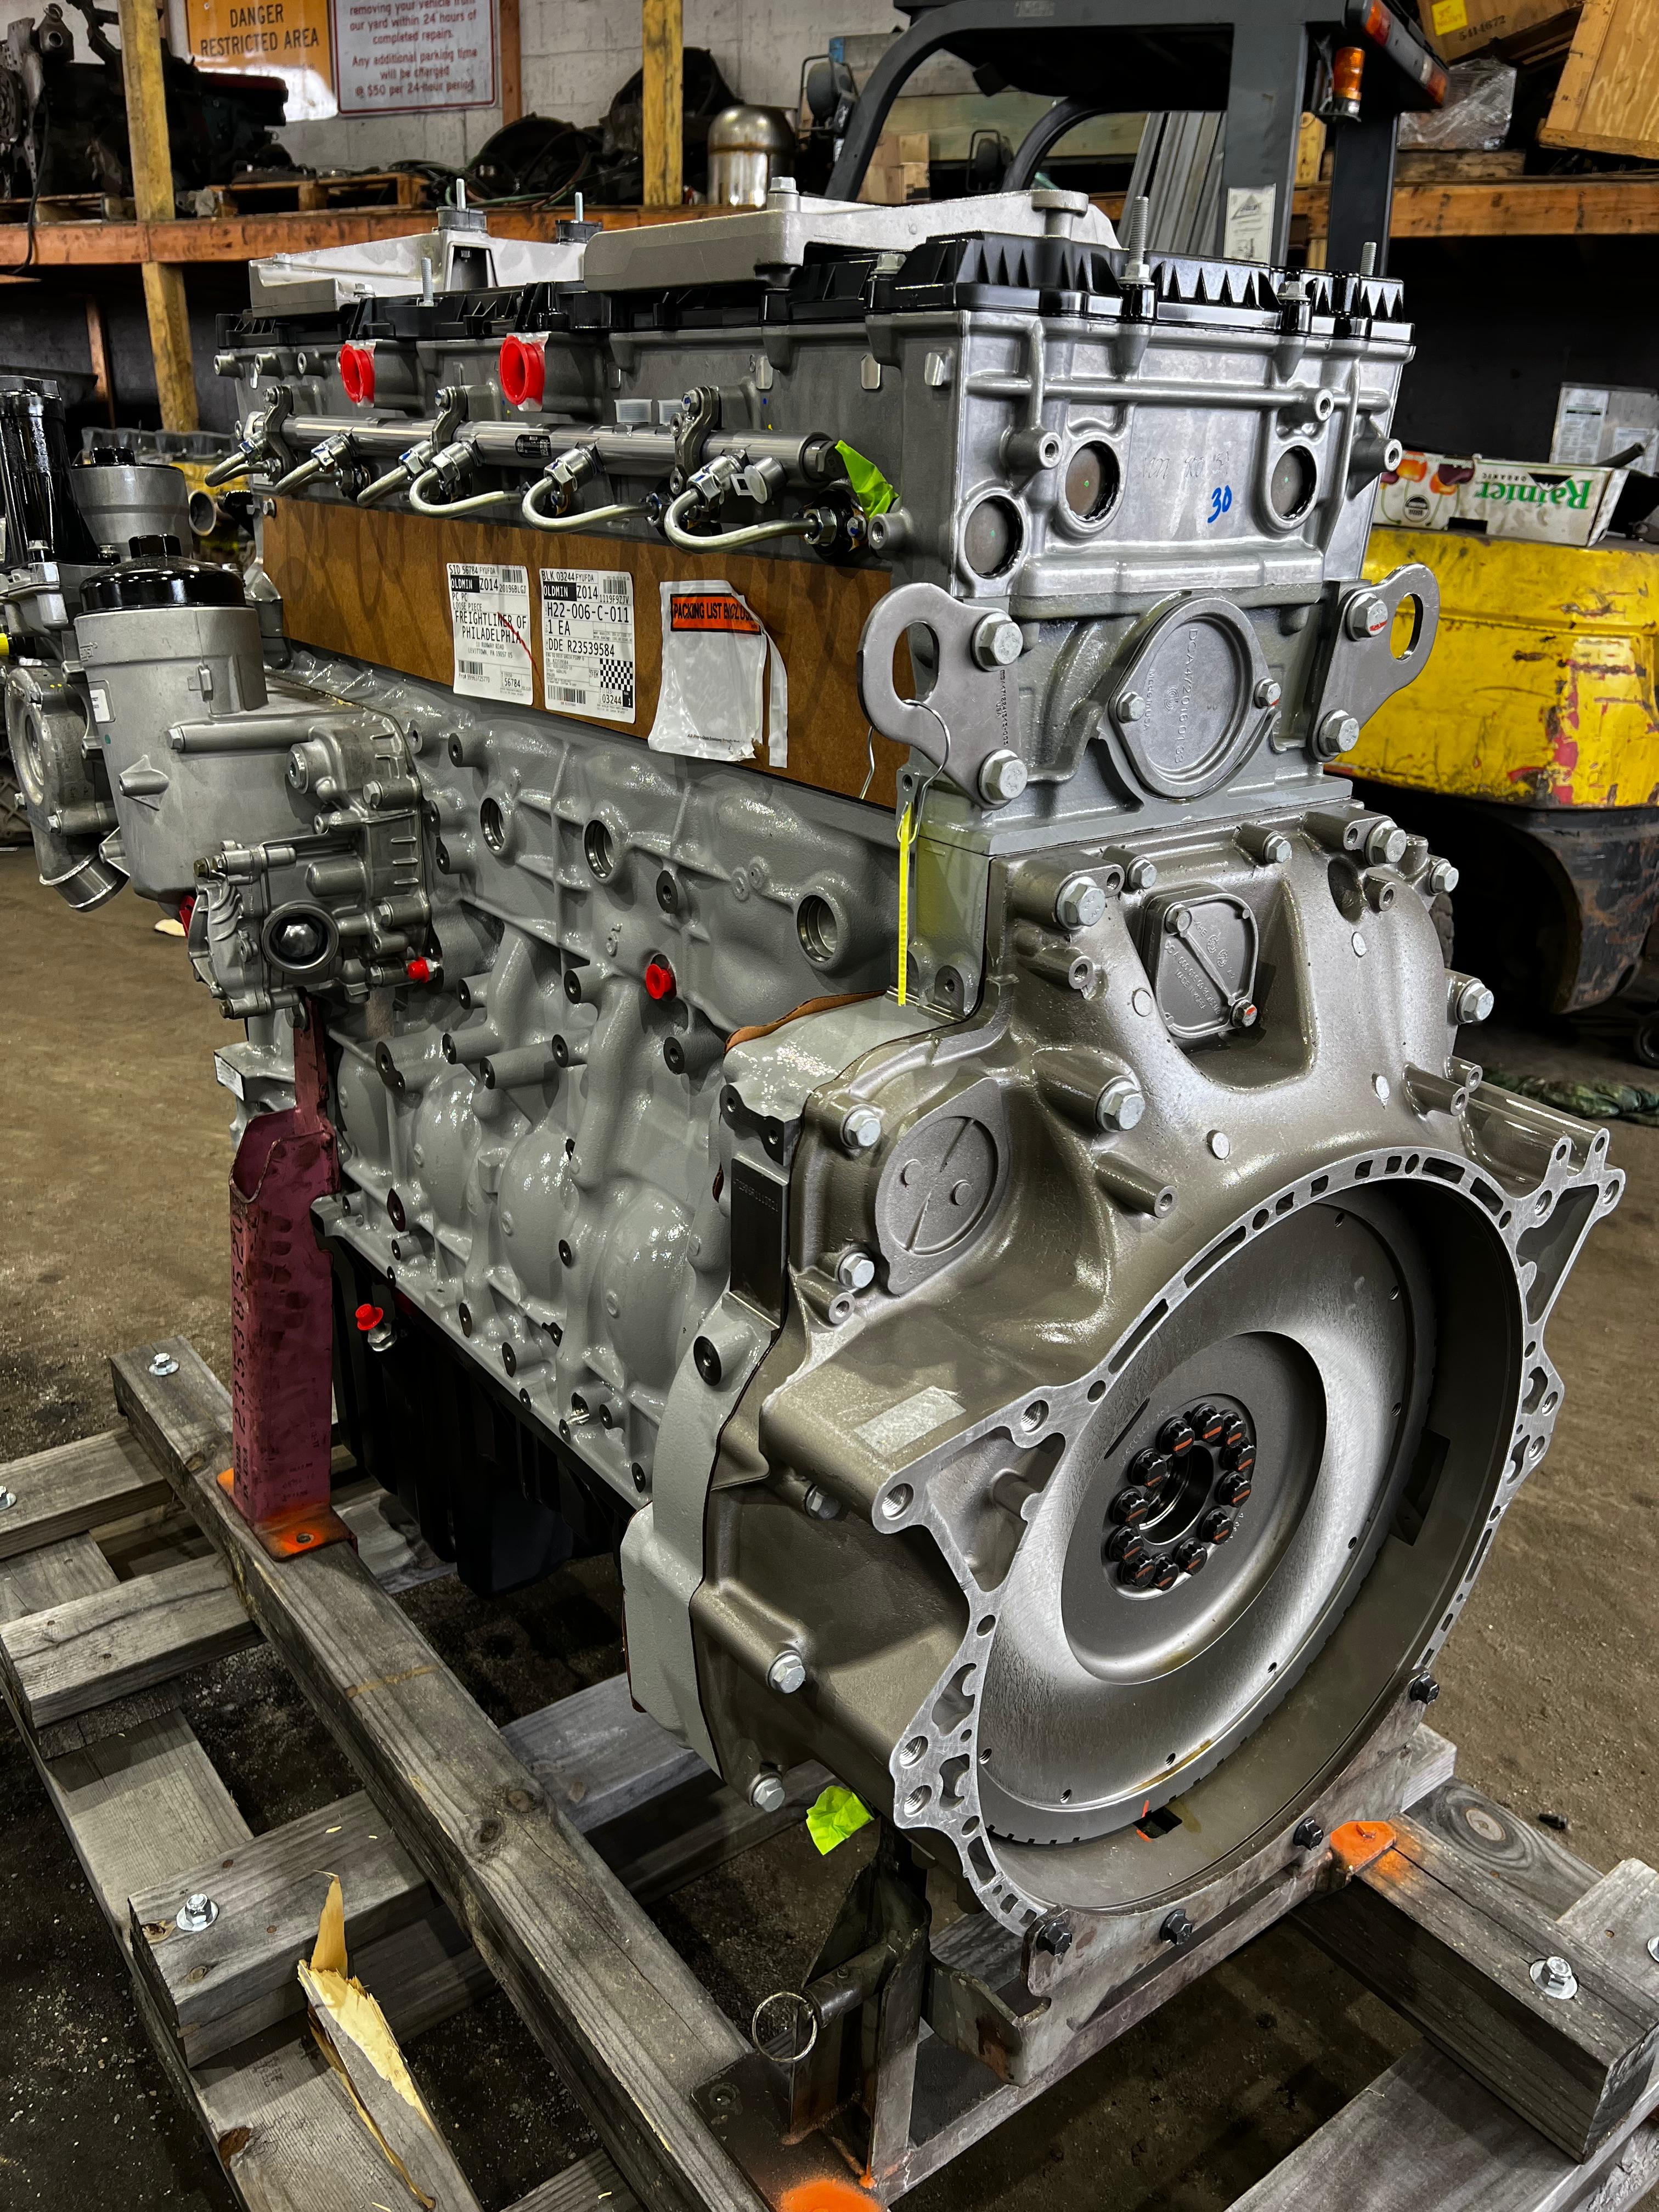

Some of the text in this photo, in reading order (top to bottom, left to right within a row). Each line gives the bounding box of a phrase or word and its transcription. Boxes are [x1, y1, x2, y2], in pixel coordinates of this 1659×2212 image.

[350, 3, 391, 15] removing
[395, 1, 415, 14] your
[419, 0, 450, 9] vehicle
[230, 4, 284, 28] DANGER
[350, 9, 477, 31] our yard within 24 hours of
[200, 27, 319, 57] RESTRICTED AREA
[373, 31, 419, 44] completed
[352, 48, 478, 69] Any additional parking time
[380, 65, 450, 80] will be charged
[367, 84, 386, 97] $50
[389, 85, 404, 97] per
[1482, 472, 1527, 482] ORGANIC
[1474, 479, 1593, 510] Rainier
[1207, 485, 1232, 523] 30
[449, 565, 460, 574] SID
[462, 566, 478, 574] 56784
[541, 571, 594, 582] BLK 03244 FYUFDA
[451, 578, 473, 590] OLDMIN
[544, 585, 568, 597] OLDMIN
[452, 592, 467, 602] PC PC
[453, 602, 482, 612] LOOSE PIECE
[547, 601, 629, 623] H22-006-C-011
[674, 602, 705, 619] PACKING
[707, 602, 722, 619] LIST
[455, 611, 527, 629] FREIGHTLINER OF
[548, 619, 571, 635] 1 EA
[462, 625, 522, 644] PHILADELPHIA
[549, 637, 615, 657] DDE R23539584
[504, 678, 521, 687] 56784
[1147, 668, 1155, 698] Made
[602, 693, 622, 706] 03244
[1143, 709, 1152, 731] USA
[1175, 969, 1190, 988] MADE
[1192, 991, 1206, 1009] KOREA
